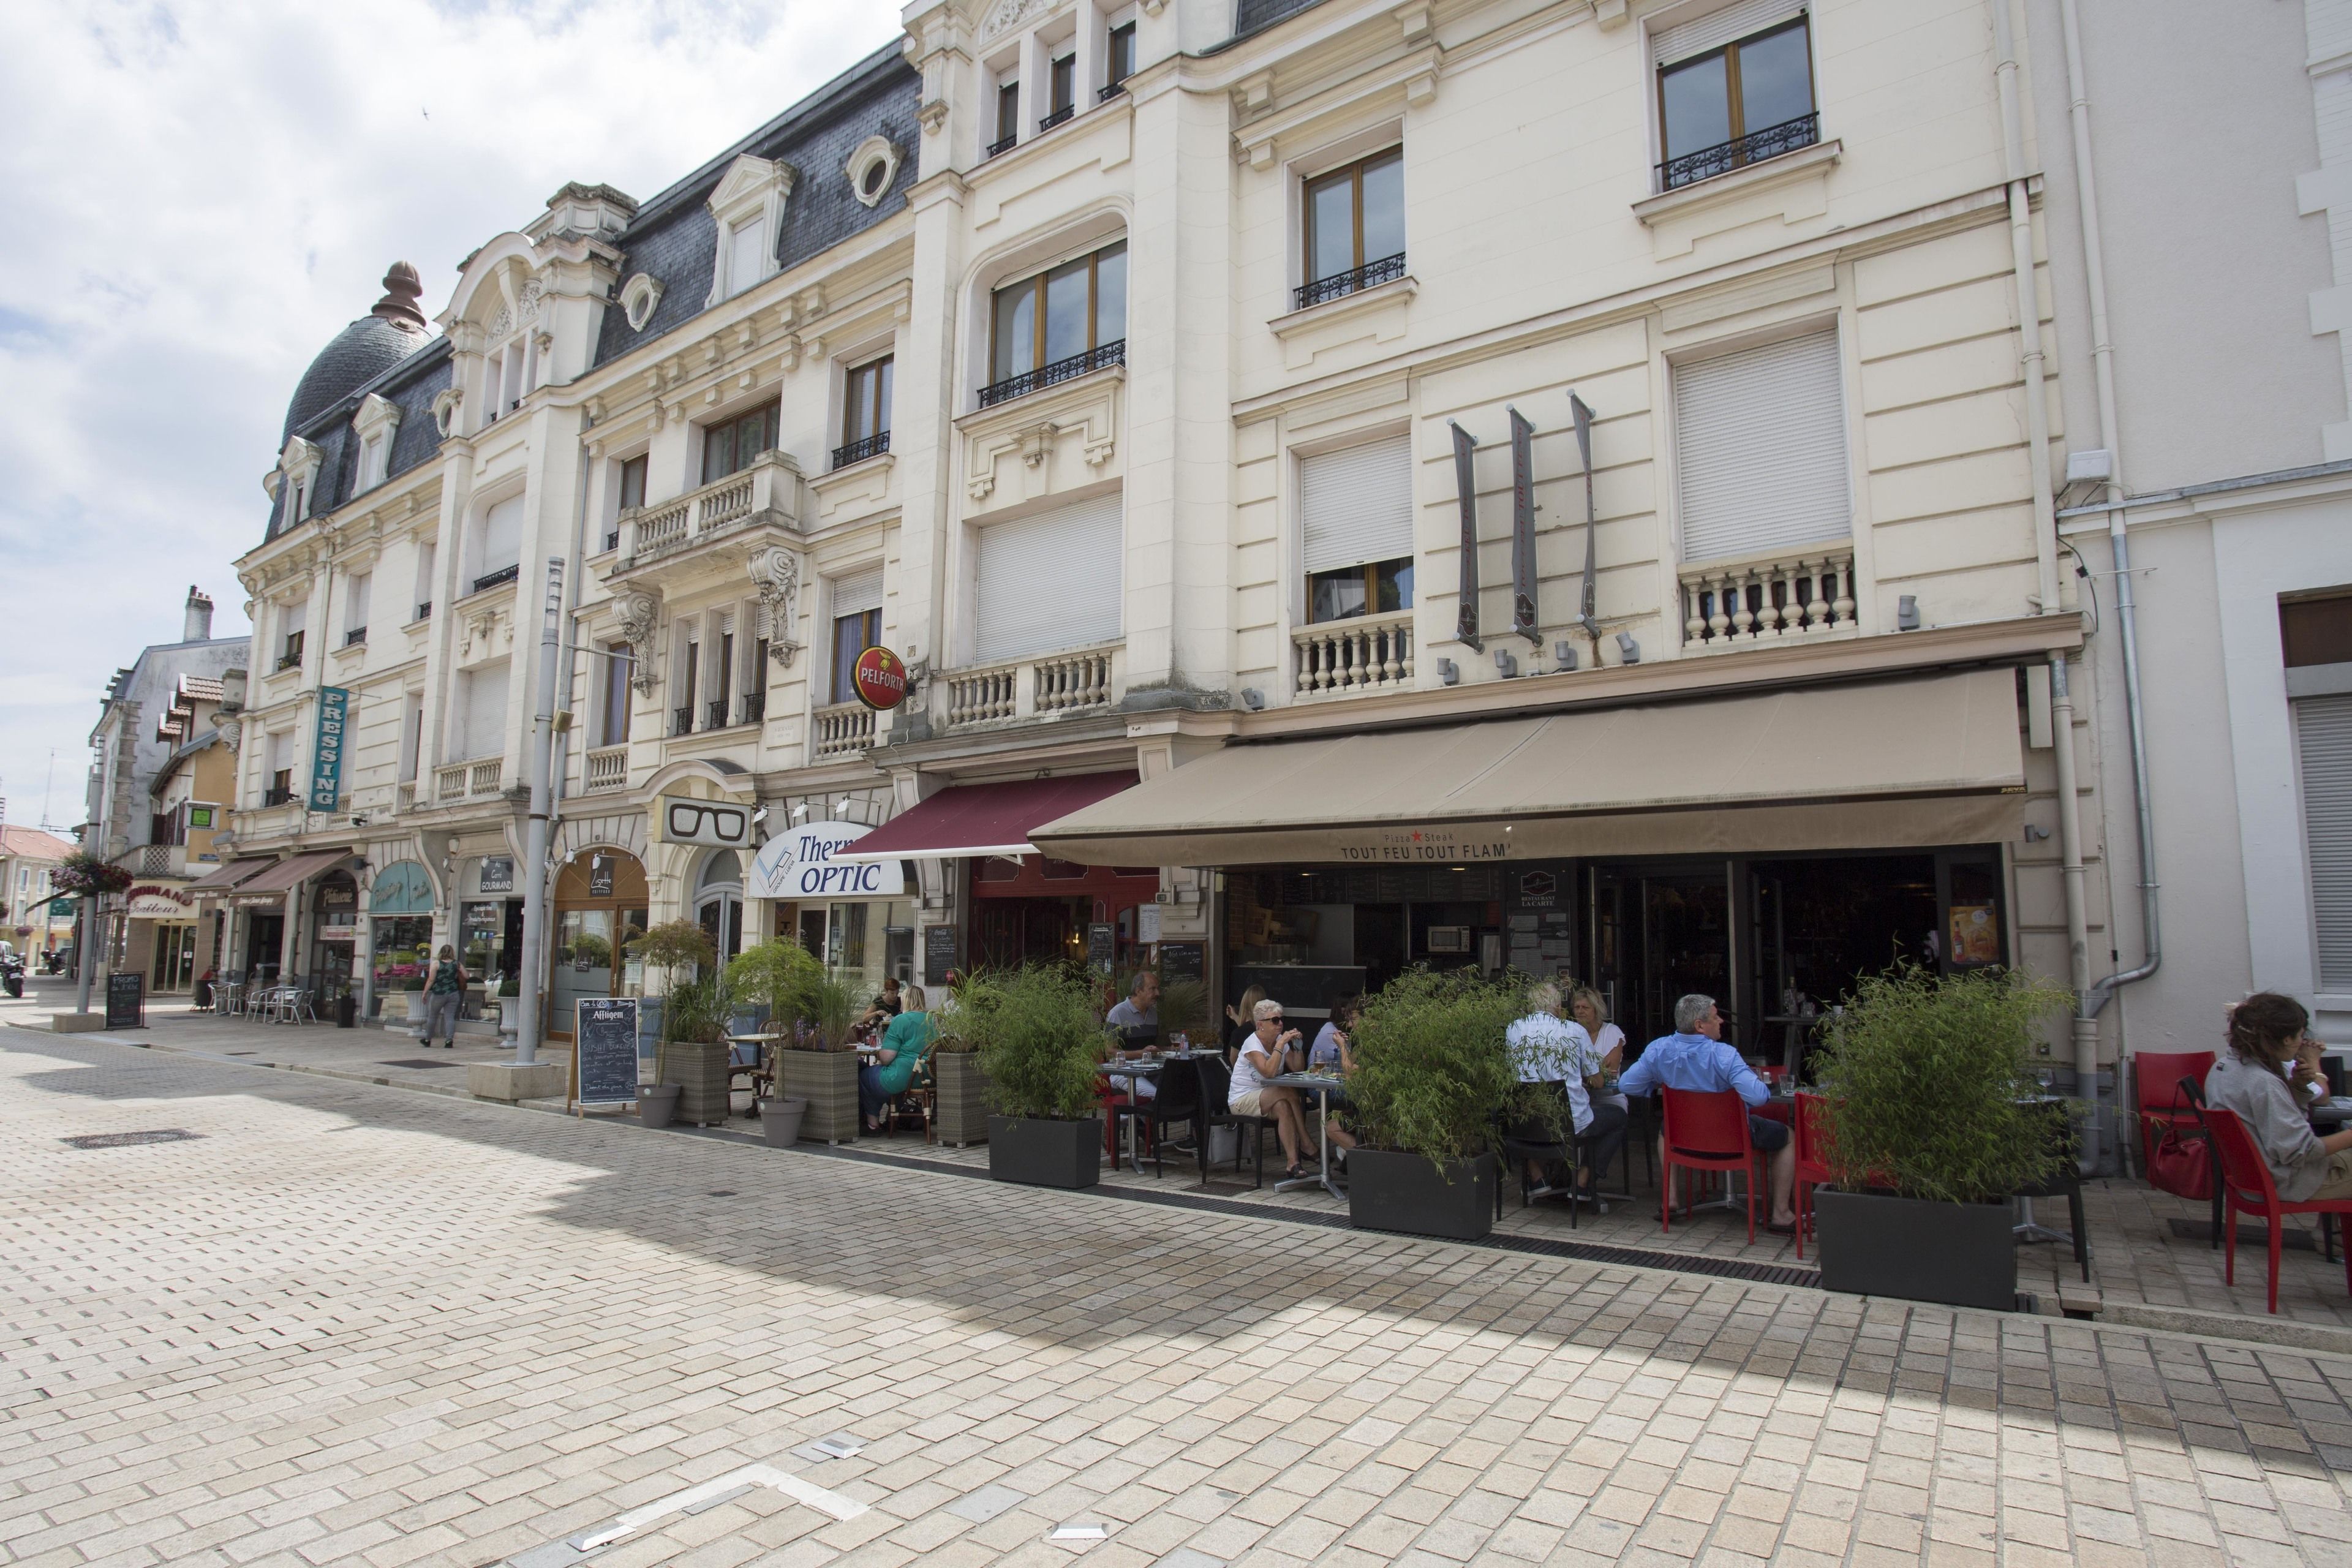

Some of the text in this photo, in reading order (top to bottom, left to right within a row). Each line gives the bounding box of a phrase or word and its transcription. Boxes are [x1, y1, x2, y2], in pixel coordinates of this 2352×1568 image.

[861, 667, 903, 692] PELFORTH
[315, 693, 344, 805] PRESSING
[1385, 832, 1453, 843] Pizza Steak
[1341, 843, 1511, 859] TOUT FEU TOUT FLAM'
[491, 870, 502, 879] Carré
[591, 870, 611, 889] Lisette
[801, 864, 881, 894] OPTIC
[481, 881, 512, 890] GOURMAND
[773, 875, 785, 894] GROUPE
[113, 975, 138, 984] PROMO
[593, 1010, 624, 1020] Affligem
[583, 1043, 605, 1052] SUSHI
